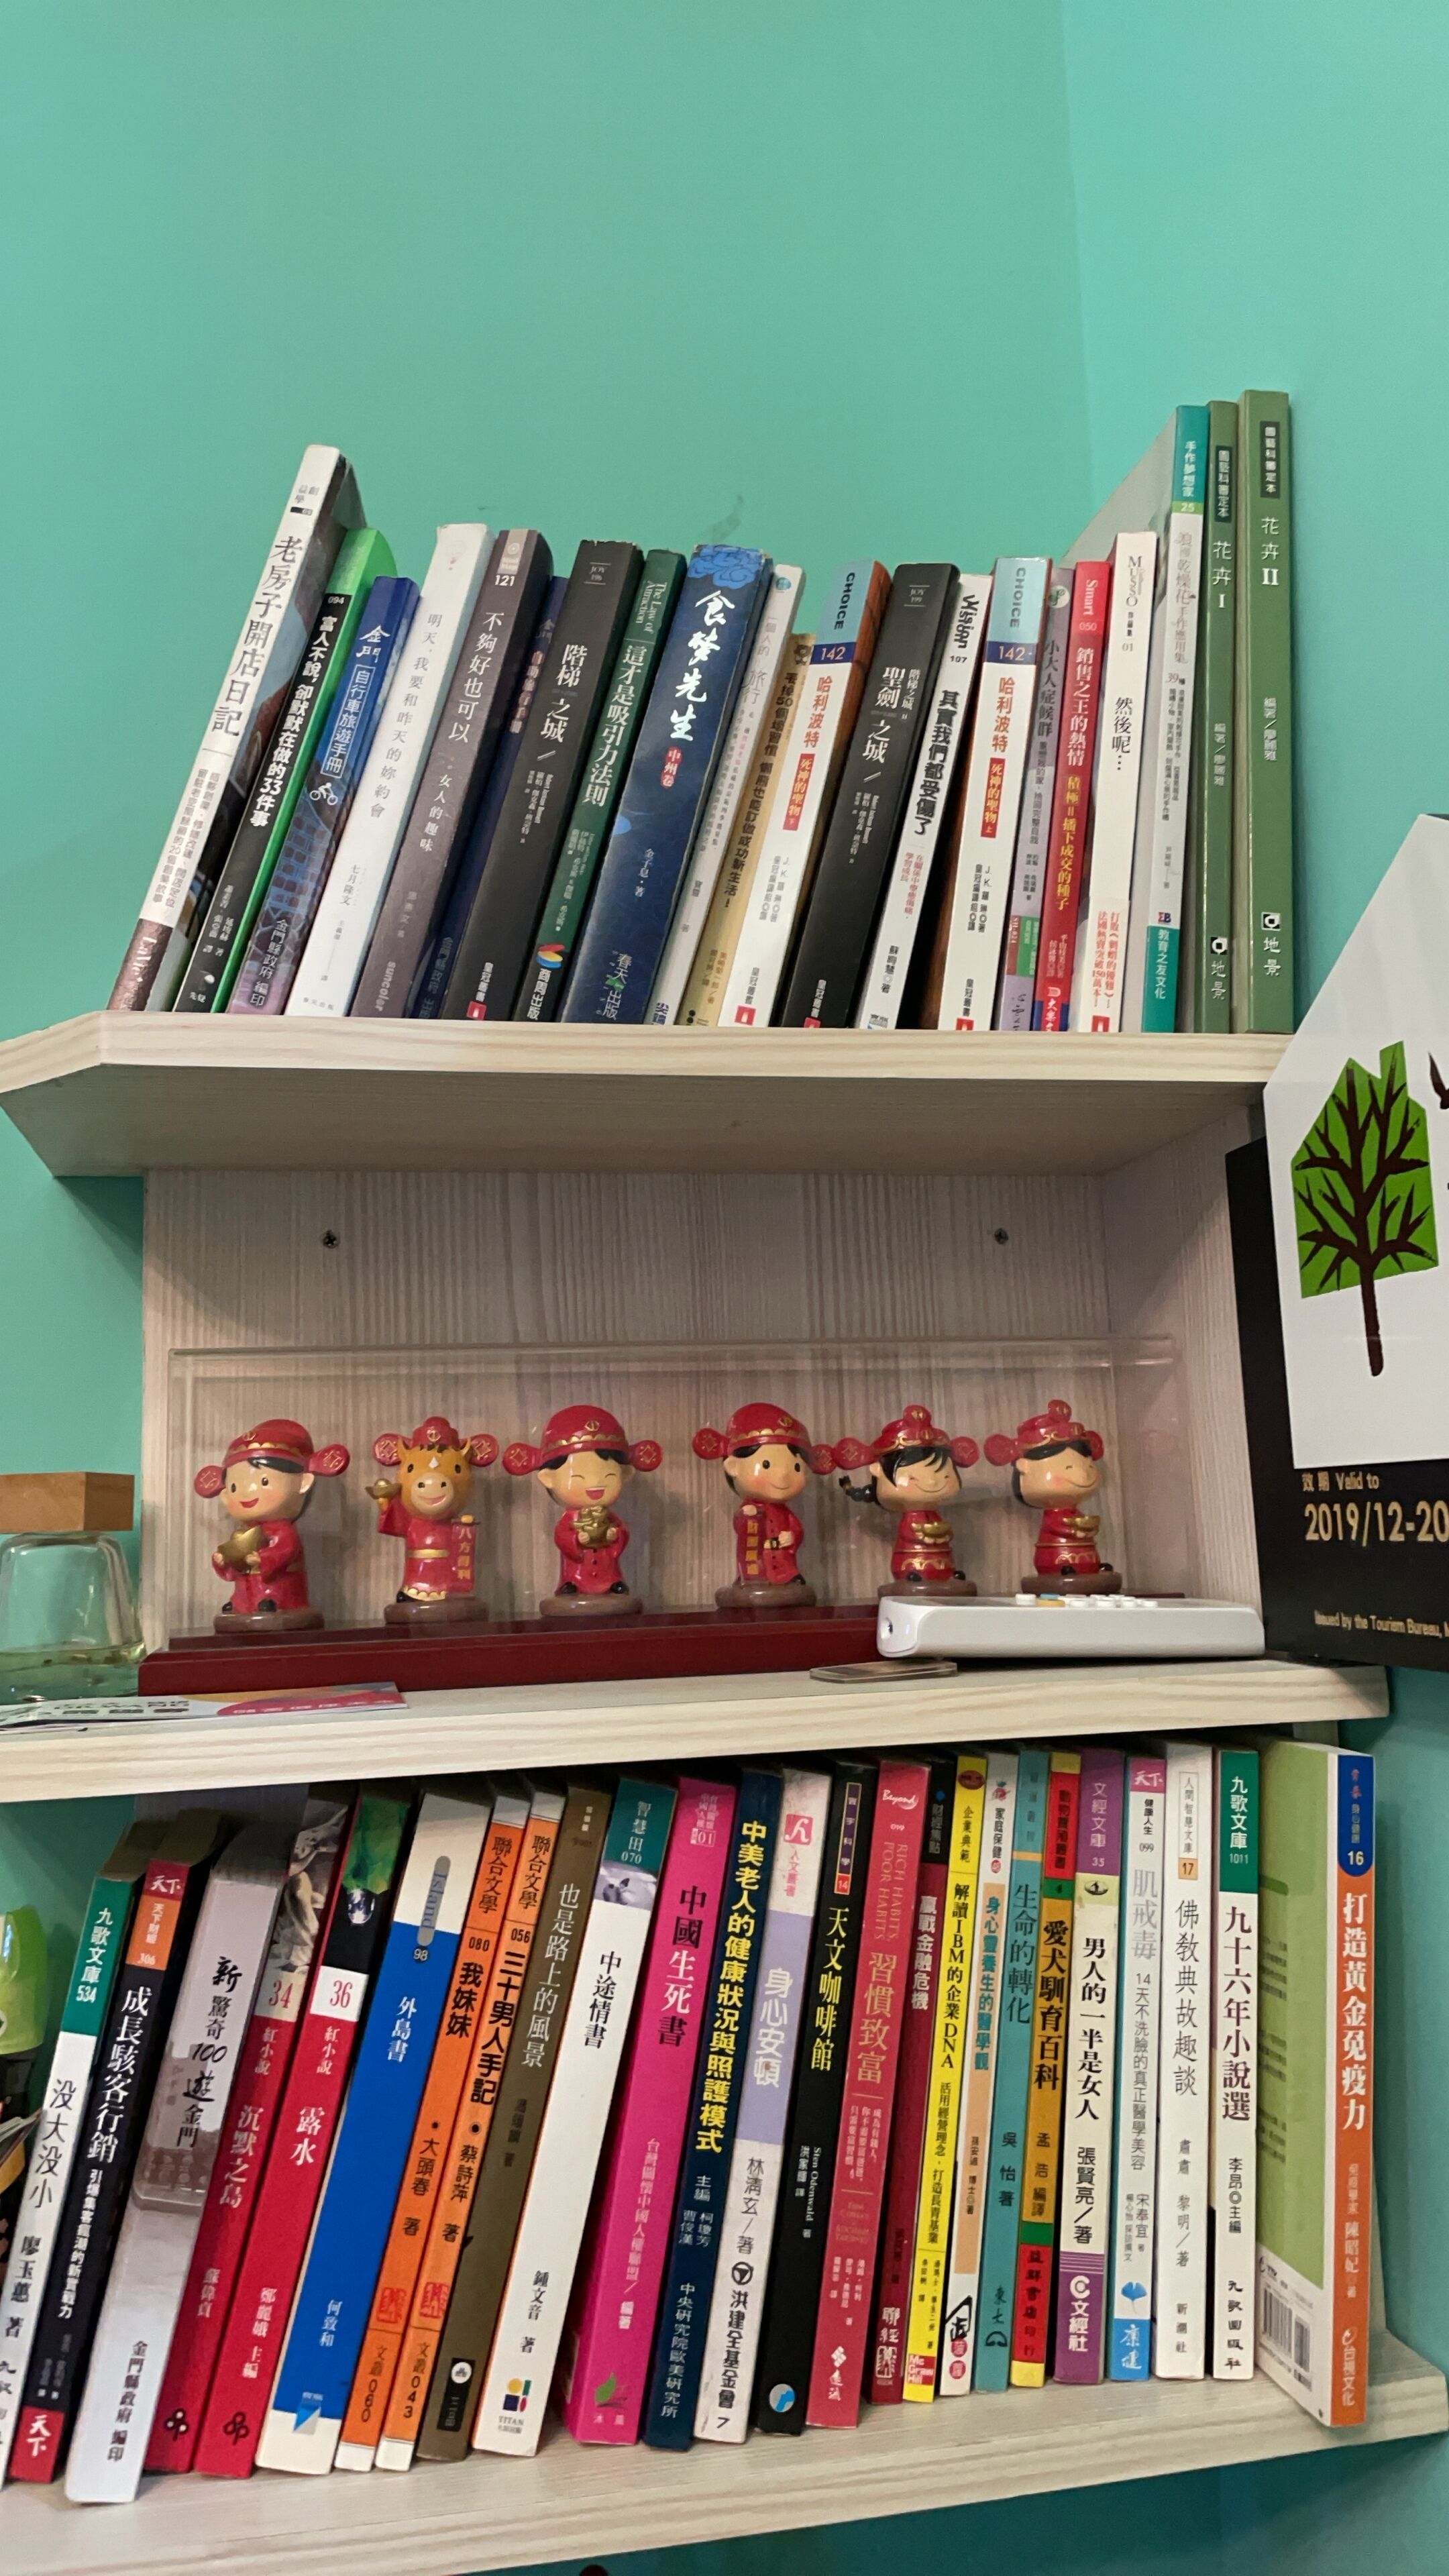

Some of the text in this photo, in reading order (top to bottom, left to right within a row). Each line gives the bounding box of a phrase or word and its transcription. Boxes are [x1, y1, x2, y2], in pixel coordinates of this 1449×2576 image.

[1182, 440, 1197, 497] 手作夢想家
[1181, 502, 1195, 512] 25
[327, 596, 345, 605] 094
[494, 574, 515, 587] 121
[834, 572, 855, 631] CHOICE
[1010, 567, 1026, 629] CHOICE
[1083, 578, 1098, 616] Smart
[1126, 555, 1143, 607] MUSSO
[212, 535, 303, 737] 老房子開店日記
[357, 625, 390, 663] 金門
[998, 645, 1024, 661] 142
[1079, 622, 1096, 631] 050
[1122, 642, 1134, 651] 01
[1126, 611, 1134, 637] 作品集
[448, 611, 504, 744] 不夠好也可以
[820, 647, 847, 661] 142
[950, 655, 967, 663] 107
[541, 643, 588, 743] 階梯之城
[803, 676, 833, 748] 哈利波特
[862, 666, 905, 763] 聖劍之城
[902, 668, 922, 710] 階梯之城
[992, 677, 1015, 751] 哈利波特
[1037, 639, 1059, 737] 小大人症候群
[1067, 647, 1094, 767] 銷售之王的熱情
[250, 615, 338, 827] 富人不說，卻默默在做的33件事
[326, 668, 373, 773] 自行車旅遊手冊
[582, 645, 648, 807] 這才是吸引力法則
[788, 759, 814, 816] 死神的聖物
[914, 690, 960, 836] 其實我們都受傷了
[420, 774, 451, 853] 女人的趣味
[984, 763, 1003, 824] 死神的聖物
[340, 863, 362, 907] 七月隆文
[250, 918, 288, 1007] 金門縣政府 編印
[1155, 928, 1171, 1000] 教育之友文化
[1212, 960, 1226, 1001] 地景
[1263, 936, 1281, 977] 地景
[375, 961, 397, 1013] suncolor
[527, 968, 551, 1020] 商周出版
[1335, 1471, 1380, 1491] Valid to
[1314, 1609, 1340, 1627] Issued
[1341, 1611, 1353, 1631] by
[1354, 1614, 1368, 1630] the
[1370, 1615, 1406, 1633] Tourism
[882, 1788, 918, 1810] Beyond
[1134, 1771, 1165, 1788] 天下
[629, 1800, 652, 1854] 智慧田
[960, 1805, 975, 1864] 企業典範
[1089, 1782, 1108, 1848] 文經文庫
[1143, 1798, 1154, 1836] 健康人生
[1183, 1776, 1195, 1855] 人間智慧文庫
[1230, 1776, 1248, 1849] 九歌文庫
[478, 1836, 512, 1914] 聯合文學
[519, 1835, 551, 1910] 聯合文學
[621, 1850, 643, 1864] 070
[1092, 1856, 1106, 1868] 35
[1139, 1842, 1154, 1854] 099
[1182, 1863, 1194, 1876] 17
[1229, 1853, 1249, 1865] 1011
[1347, 1850, 1364, 1866] 16
[151, 1875, 181, 1895] 天下
[421, 1872, 447, 1930] Island
[839, 1881, 849, 1890] 14
[875, 1841, 895, 1941] POOR HABITS
[889, 1842, 909, 1940] RICH HABITS
[146, 1902, 164, 1944] 天下財經
[511, 1929, 531, 1943] 056
[1130, 1868, 1159, 1961] 肌戒毒
[81, 1908, 113, 1984] 九歌文庫
[137, 1953, 156, 1966] 306
[413, 1948, 429, 1962] 98
[468, 1936, 491, 1952] 080
[657, 1884, 707, 2047] 中國生死書
[911, 1895, 938, 2011] 贏戰金融危機
[1007, 1884, 1038, 2025] 生命的轉化
[76, 1984, 97, 2003] 534
[269, 1980, 293, 2010] 34
[329, 1980, 352, 2009] 36
[445, 1962, 484, 2039] 我妹妹
[521, 1884, 581, 2069] 也是路上的風景
[584, 1951, 623, 2049] 中途情書
[695, 1820, 767, 2154] 中美老人的健康狀況與照護模式
[810, 1907, 849, 2072] 天文咖啡館
[940, 1882, 971, 2069] 解讀IBM的企業DNA
[387, 1996, 417, 2063] 外島書
[470, 1950, 527, 2106] 三十男人手記
[753, 1968, 793, 2088] 身心安頓
[857, 1952, 898, 2085] 習慣致富
[1034, 1920, 1069, 2091] 愛犬馴育百科
[1074, 1937, 1108, 2122] 男人的一半是女人
[1222, 1906, 1253, 2122] 九十六年小說選
[1342, 1892, 1368, 2131] 打造黃金免疫力
[87, 1986, 153, 2164] 成長駭客行銷
[255, 2027, 278, 2076] 紅小說
[317, 2027, 341, 2076] 紅小說
[1130, 1972, 1152, 2171] 14天不洗臉的真正醫學美容
[219, 2104, 262, 2210] 沉默之島
[290, 2106, 326, 2166] 露水
[1035, 2133, 1051, 2179] 孟浩
[402, 2138, 441, 2237] 大頭春 著
[442, 2143, 479, 2244] 蔡詩萍 著
[694, 2175, 712, 2202] 主編
[806, 2147, 822, 2222] Sten Odenwald
[678, 2209, 697, 2246] 曹俊漢
[11, 2235, 42, 2303] 廖玉蕙
[197, 2267, 220, 2319] 蘇偉貞
[319, 2299, 343, 2349] 何致和
[520, 2269, 550, 2354] 鍾文音 著
[879, 2306, 902, 2344] 聯經
[1069, 2299, 1090, 2353] 文經社
[241, 2345, 264, 2380] 主編
[660, 2282, 696, 2418] 中央研究院歐美研究所
[718, 2289, 750, 2410] 洪建全基金會
[908, 2365, 934, 2377] Graw
[1120, 2324, 1142, 2370] 康健
[107, 2340, 148, 2463] 金門縣政府 編印
[498, 2416, 525, 2426] TITAN
[27, 2415, 51, 2458] 天下
